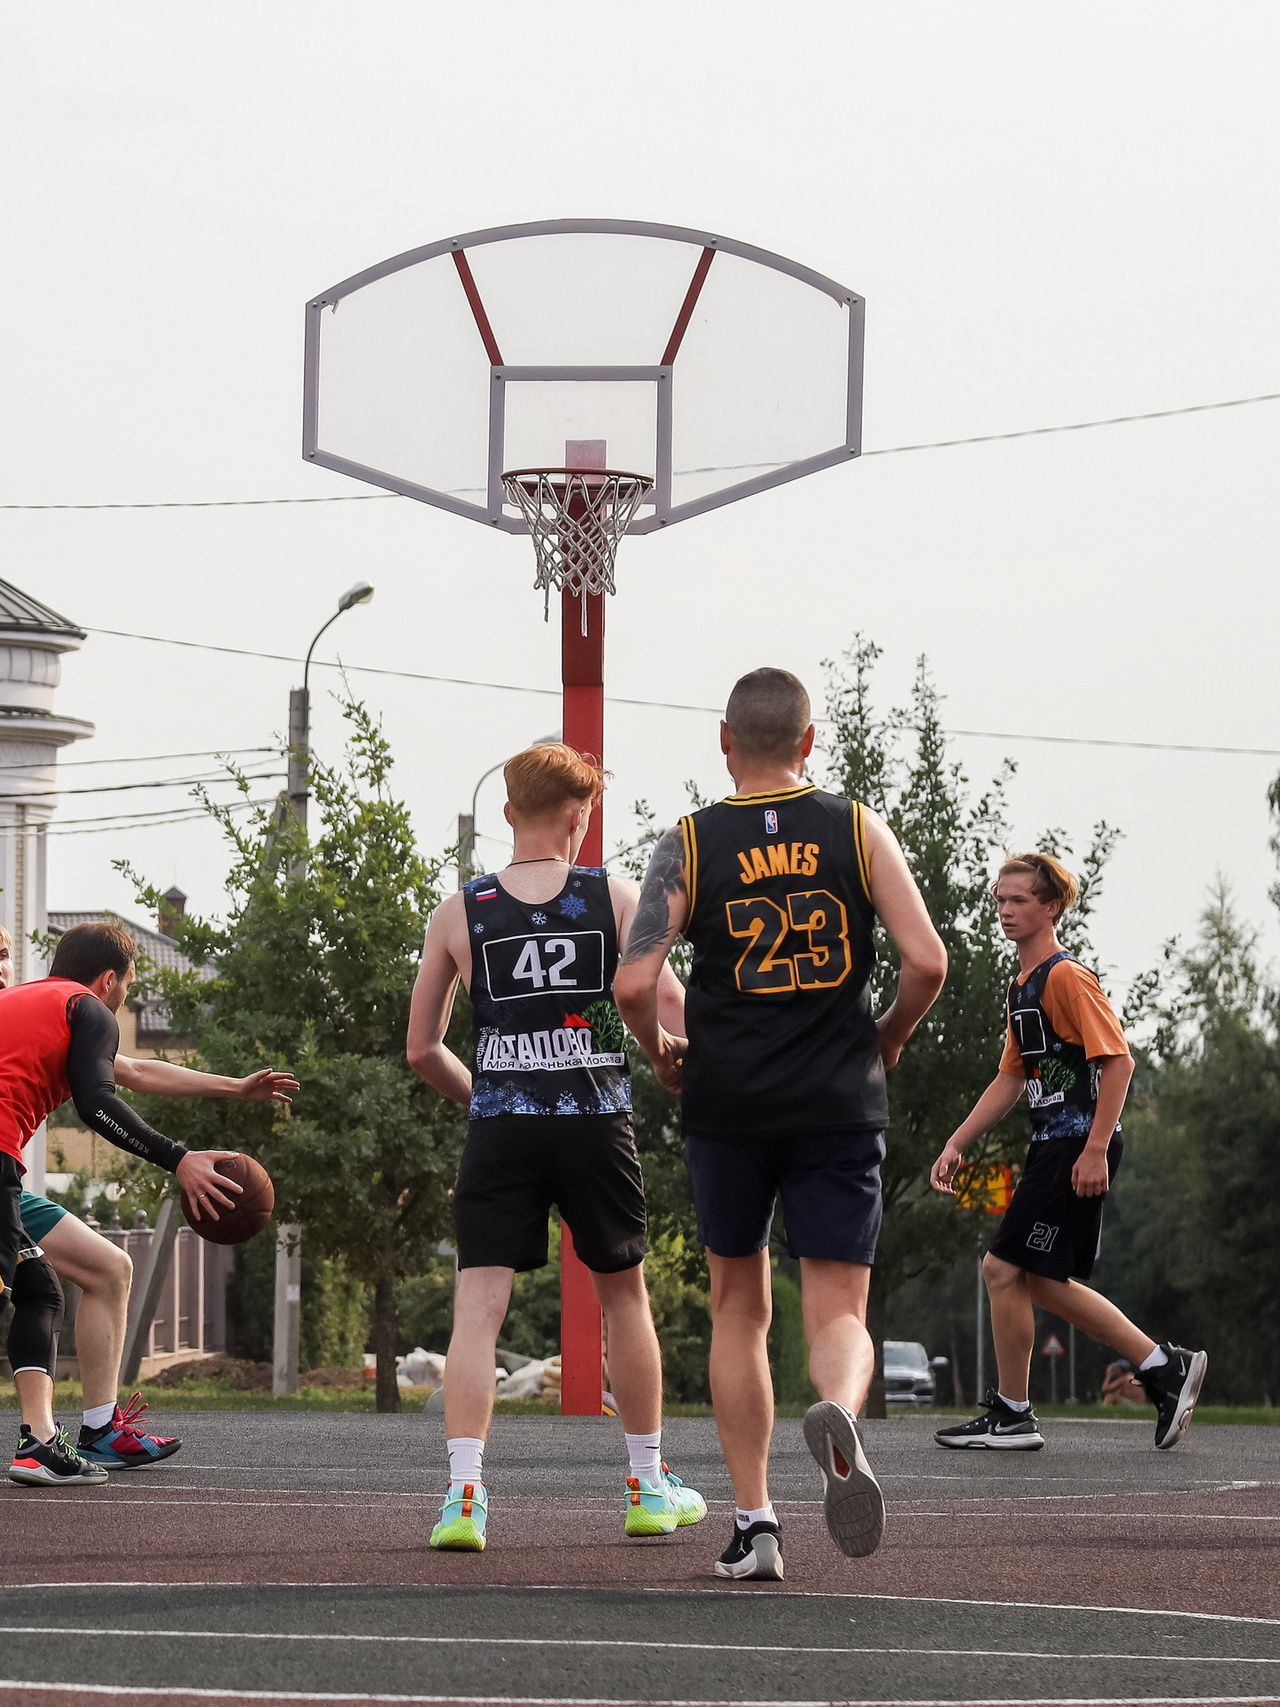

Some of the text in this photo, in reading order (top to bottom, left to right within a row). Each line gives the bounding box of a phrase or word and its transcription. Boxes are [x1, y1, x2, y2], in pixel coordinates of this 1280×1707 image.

[736, 842, 820, 885] JAMES
[512, 938, 578, 988] 42
[725, 889, 853, 994] 23
[486, 1060, 515, 1070] Моя
[95, 1109, 150, 1154] KEEP ROLLING
[1026, 1221, 1060, 1252] 21
